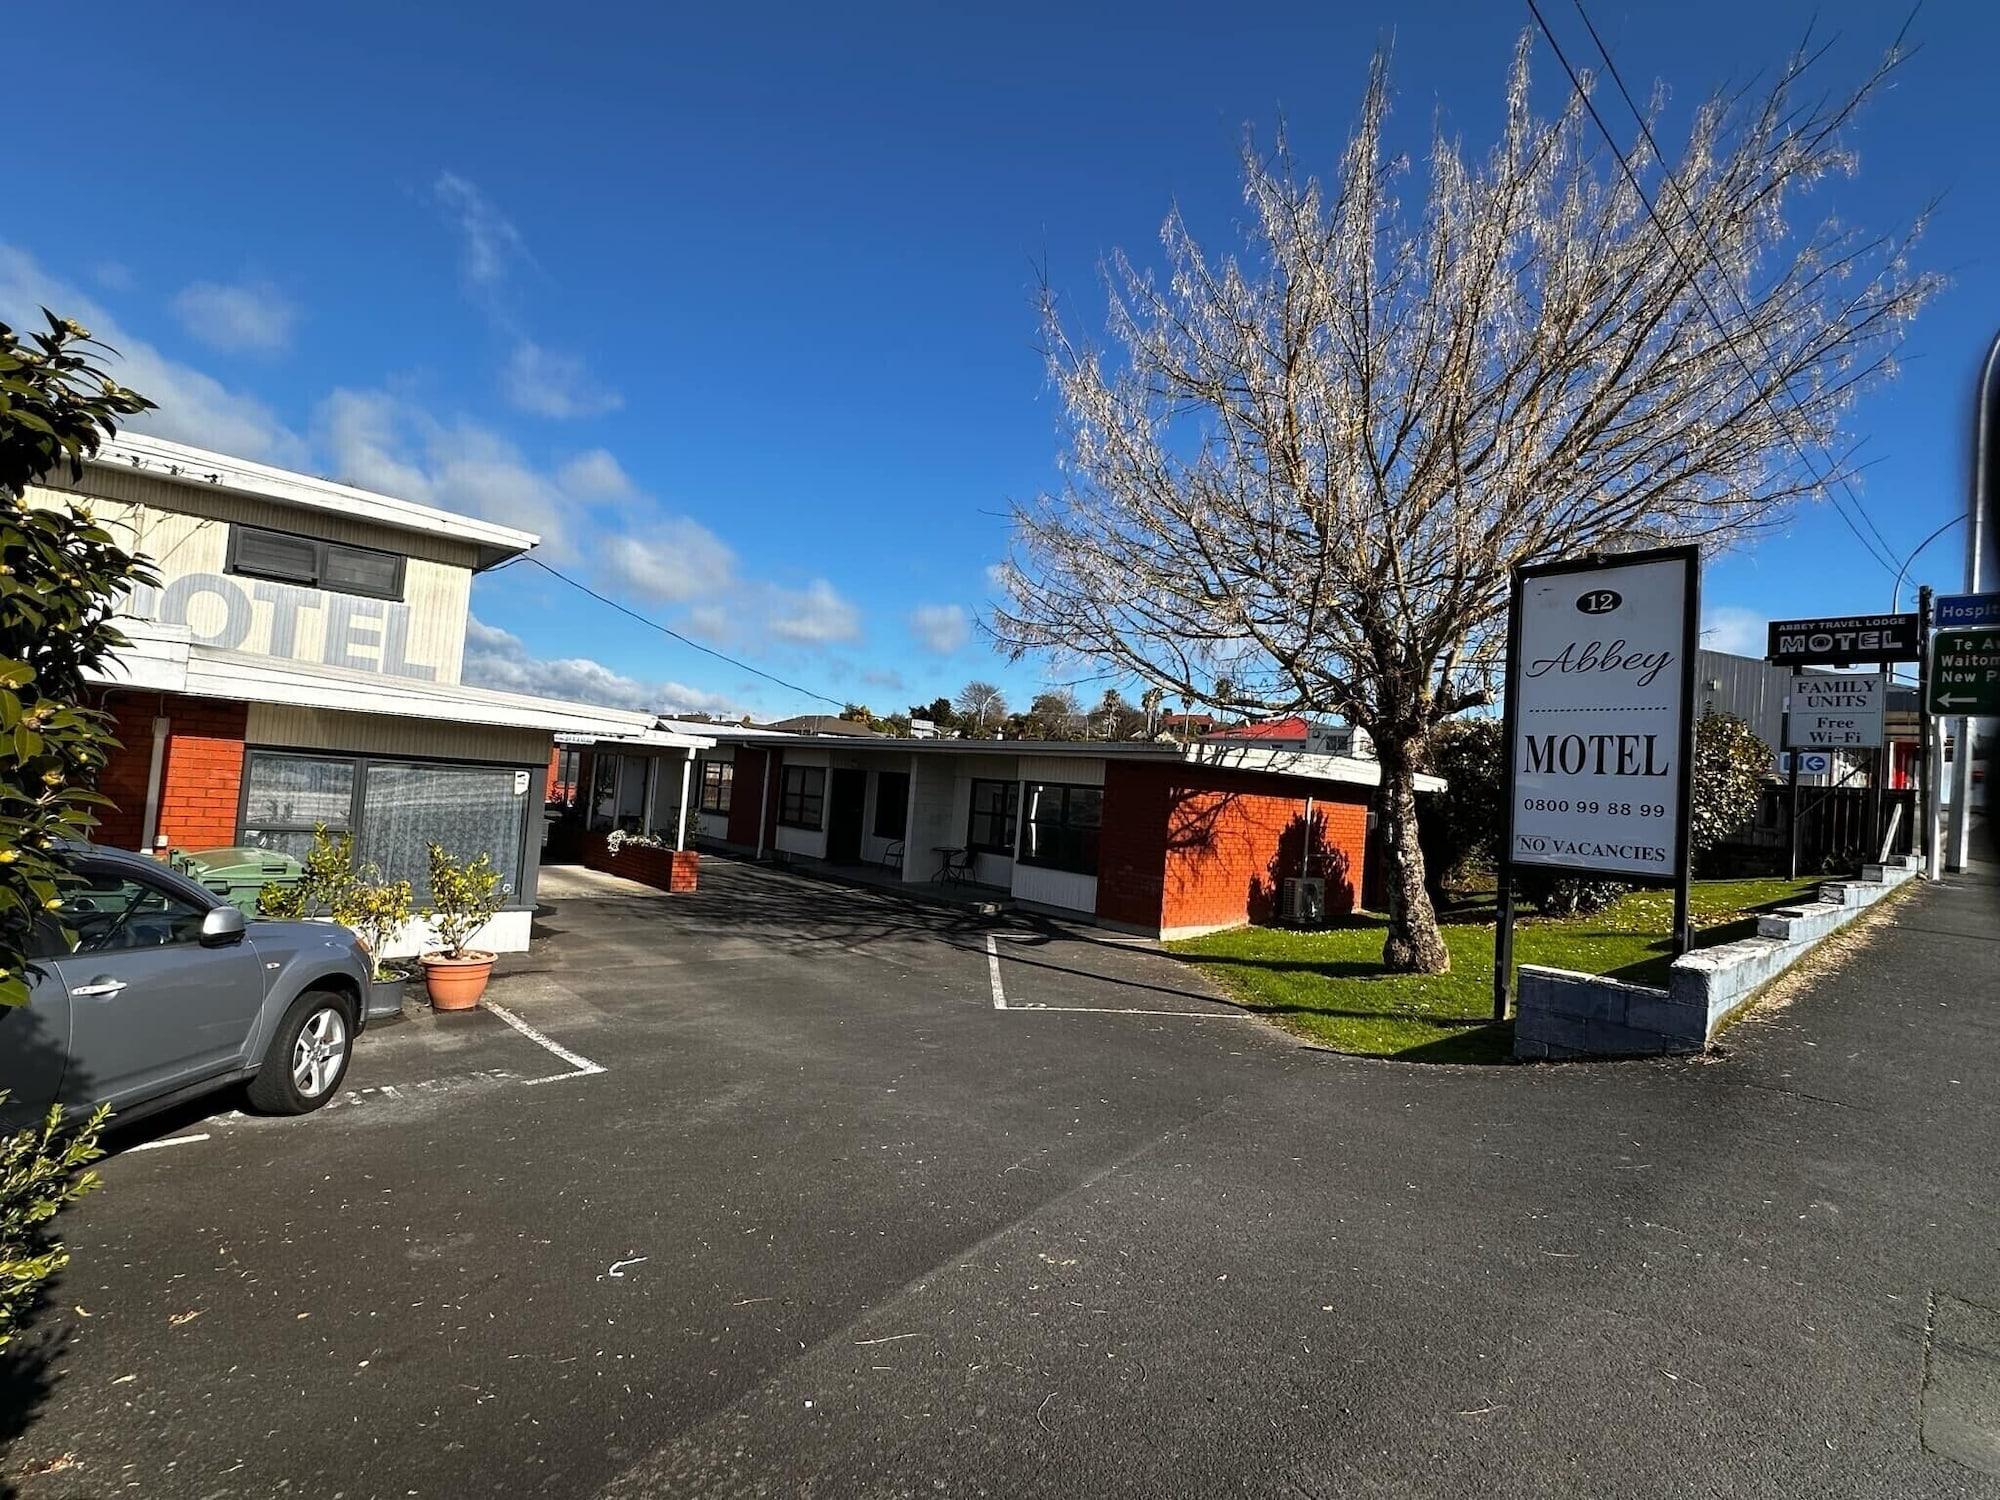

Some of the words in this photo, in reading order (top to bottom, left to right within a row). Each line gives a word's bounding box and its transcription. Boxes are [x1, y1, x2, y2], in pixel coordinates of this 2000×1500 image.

[1586, 593, 1614, 612] 12
[1779, 623, 1816, 631] ABBEY
[1818, 619, 1862, 629] TRAVEL
[1866, 617, 1906, 627] LODGE
[1779, 630, 1903, 653] MOTEL
[1954, 639, 1973, 650] Te
[1525, 639, 1674, 687] Abbey
[1941, 671, 1976, 683] New
[1797, 680, 1877, 694] FAMILY
[1807, 694, 1867, 708] UNITS
[1817, 717, 1854, 729] Free
[1809, 731, 1861, 743] Wi-Fi
[1523, 734, 1669, 777] MOTEL
[1524, 798, 1569, 813] 0800
[1576, 801, 1599, 815] 99
[1607, 802, 1631, 816] 88
[1640, 804, 1665, 818] 99
[1520, 836, 1546, 852] NO
[1552, 838, 1666, 863] VACANCIES
